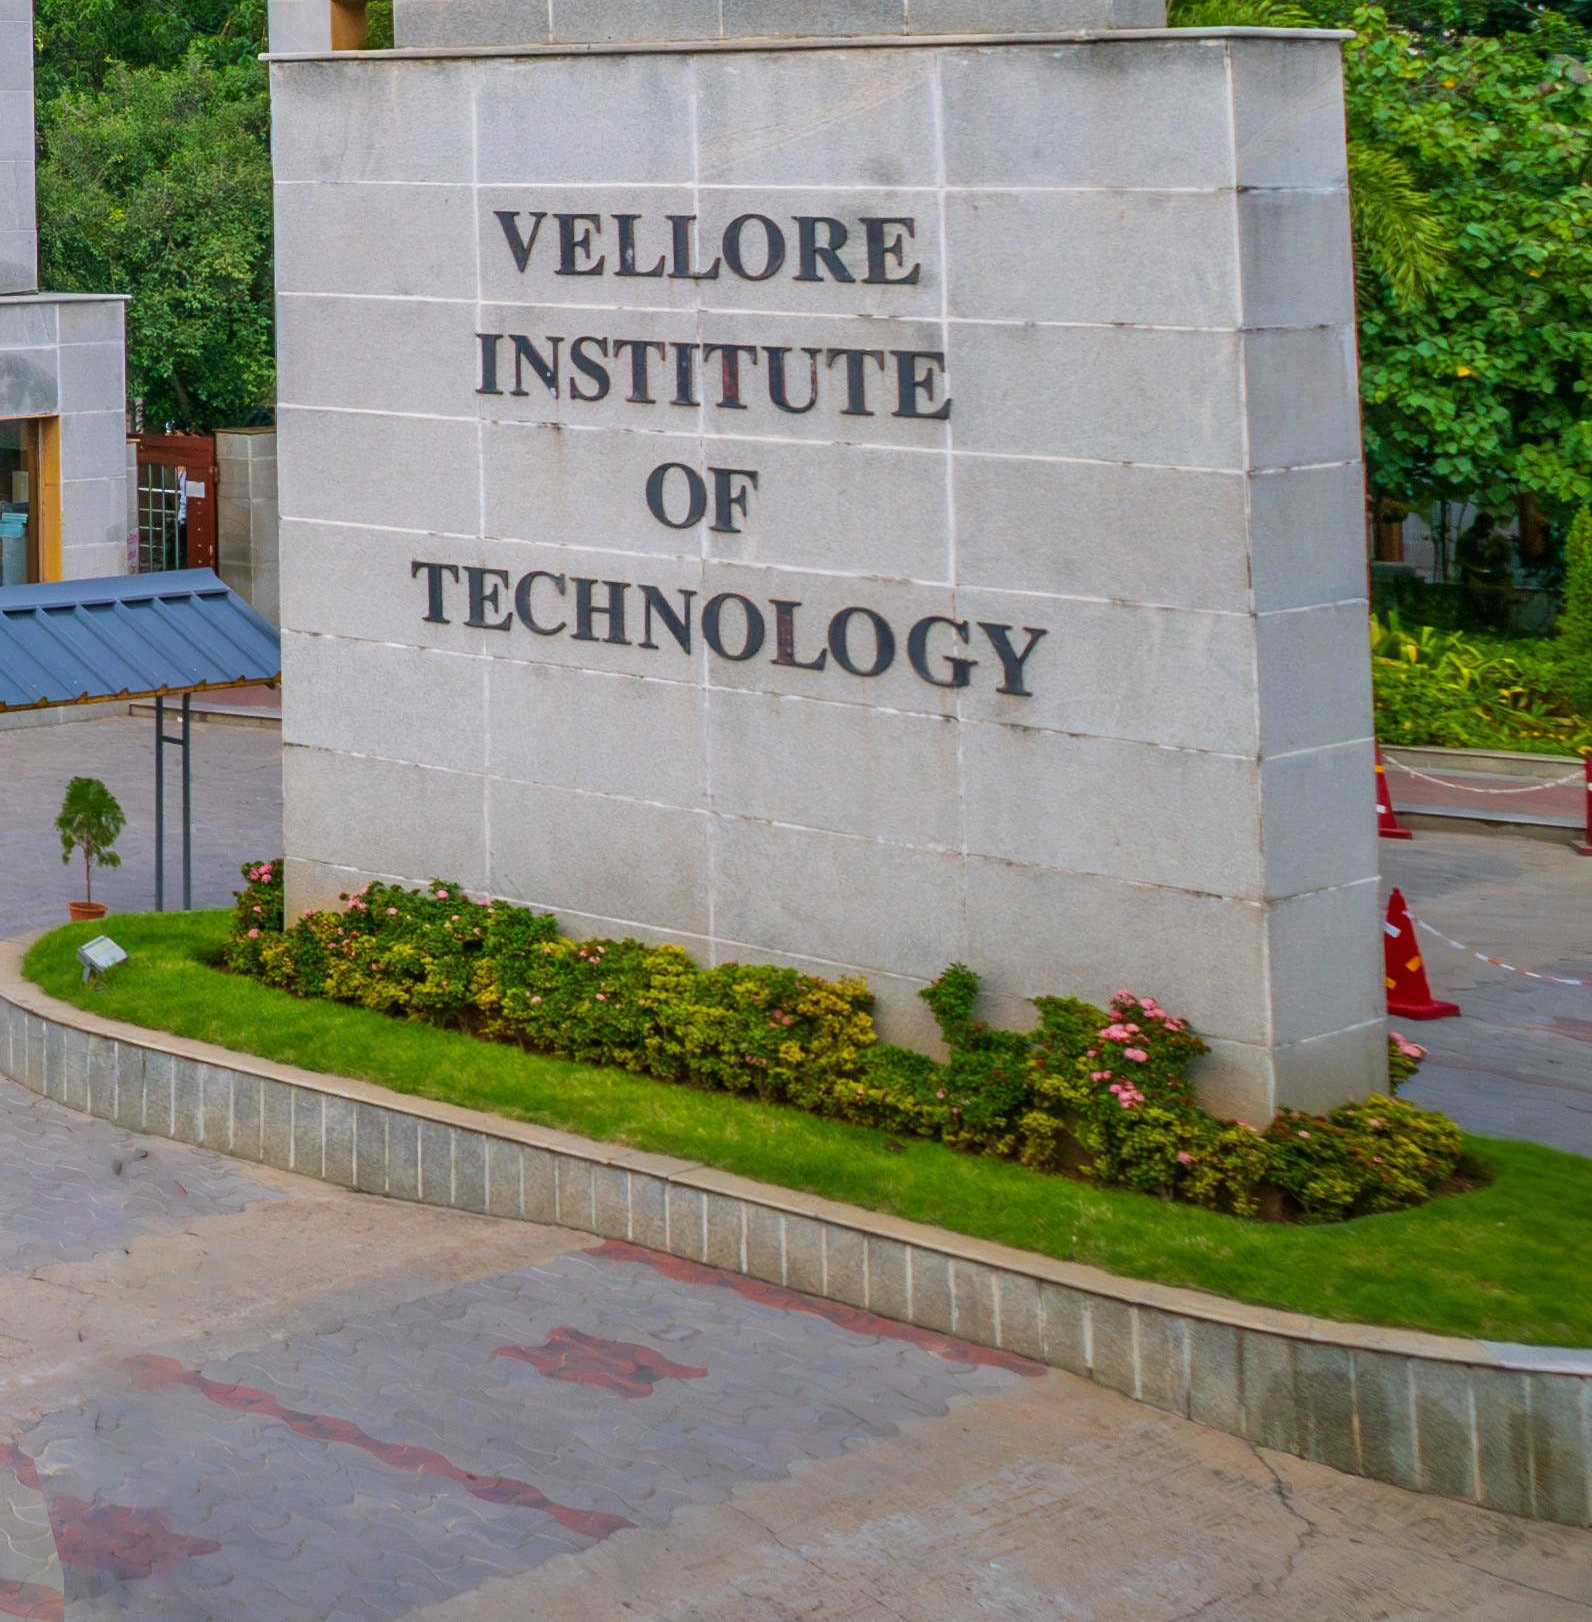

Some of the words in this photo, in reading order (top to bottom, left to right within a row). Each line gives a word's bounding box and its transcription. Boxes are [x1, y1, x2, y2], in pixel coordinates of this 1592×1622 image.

[494, 210, 922, 285] VELLORE
[475, 333, 952, 420] INSTITUTE
[645, 462, 759, 533] OF
[411, 560, 1048, 697] TECHNOLOGY
